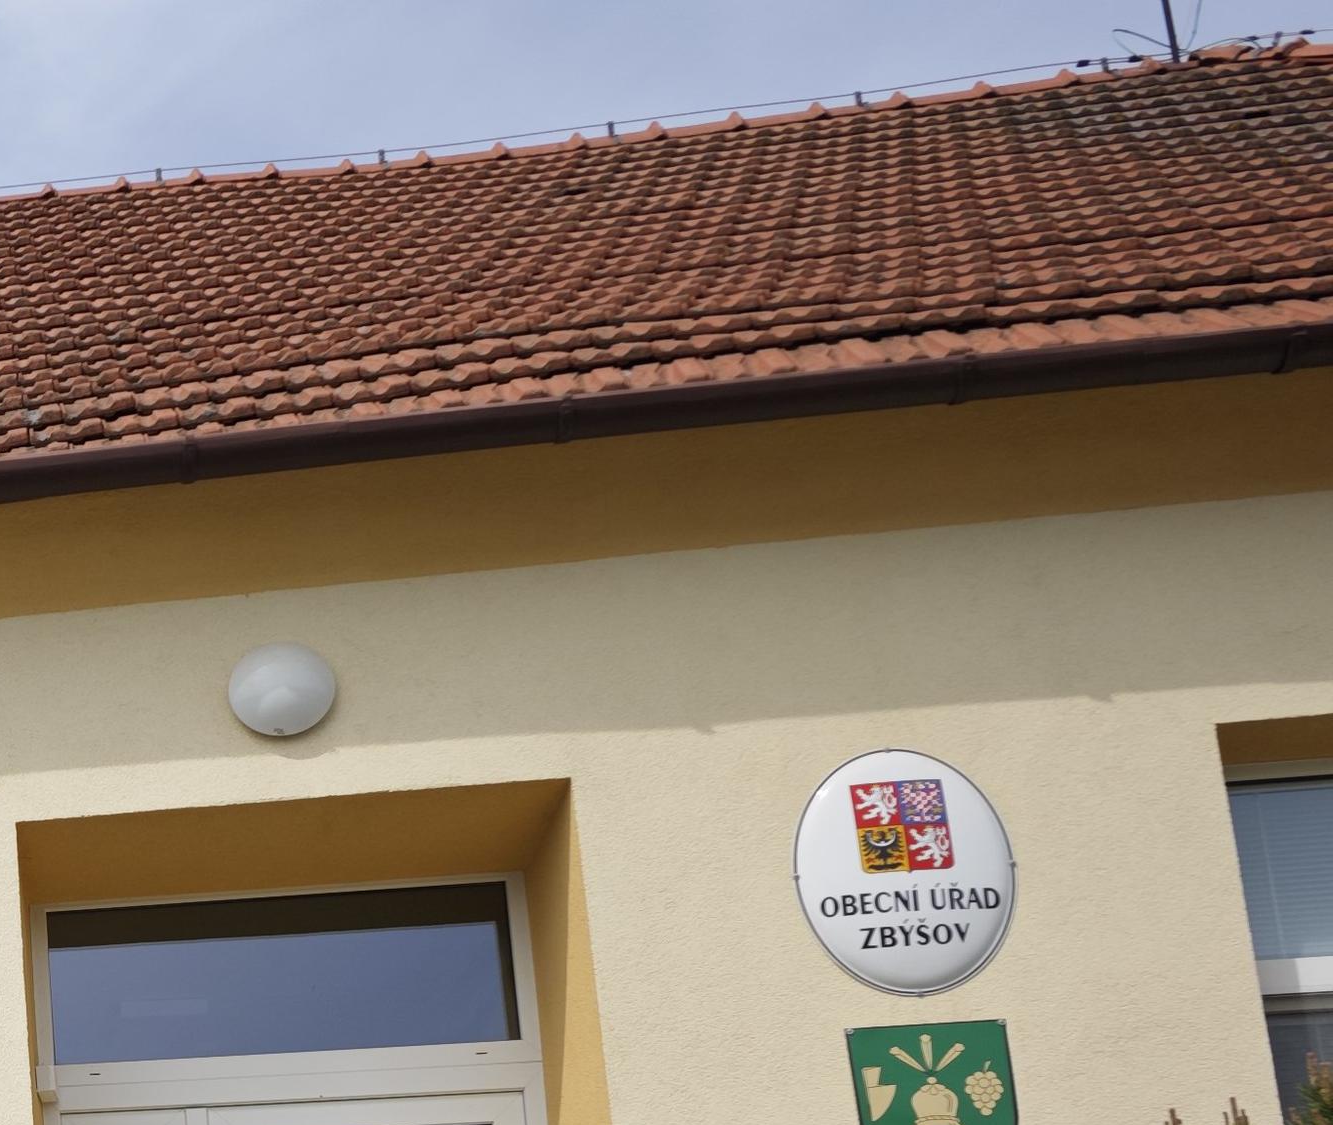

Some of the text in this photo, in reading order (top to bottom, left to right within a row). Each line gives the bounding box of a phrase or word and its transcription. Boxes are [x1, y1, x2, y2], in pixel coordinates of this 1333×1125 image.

[820, 881, 1002, 919] OBECNÍ ÚŘAD
[859, 918, 971, 950] ZBÝŠOV
